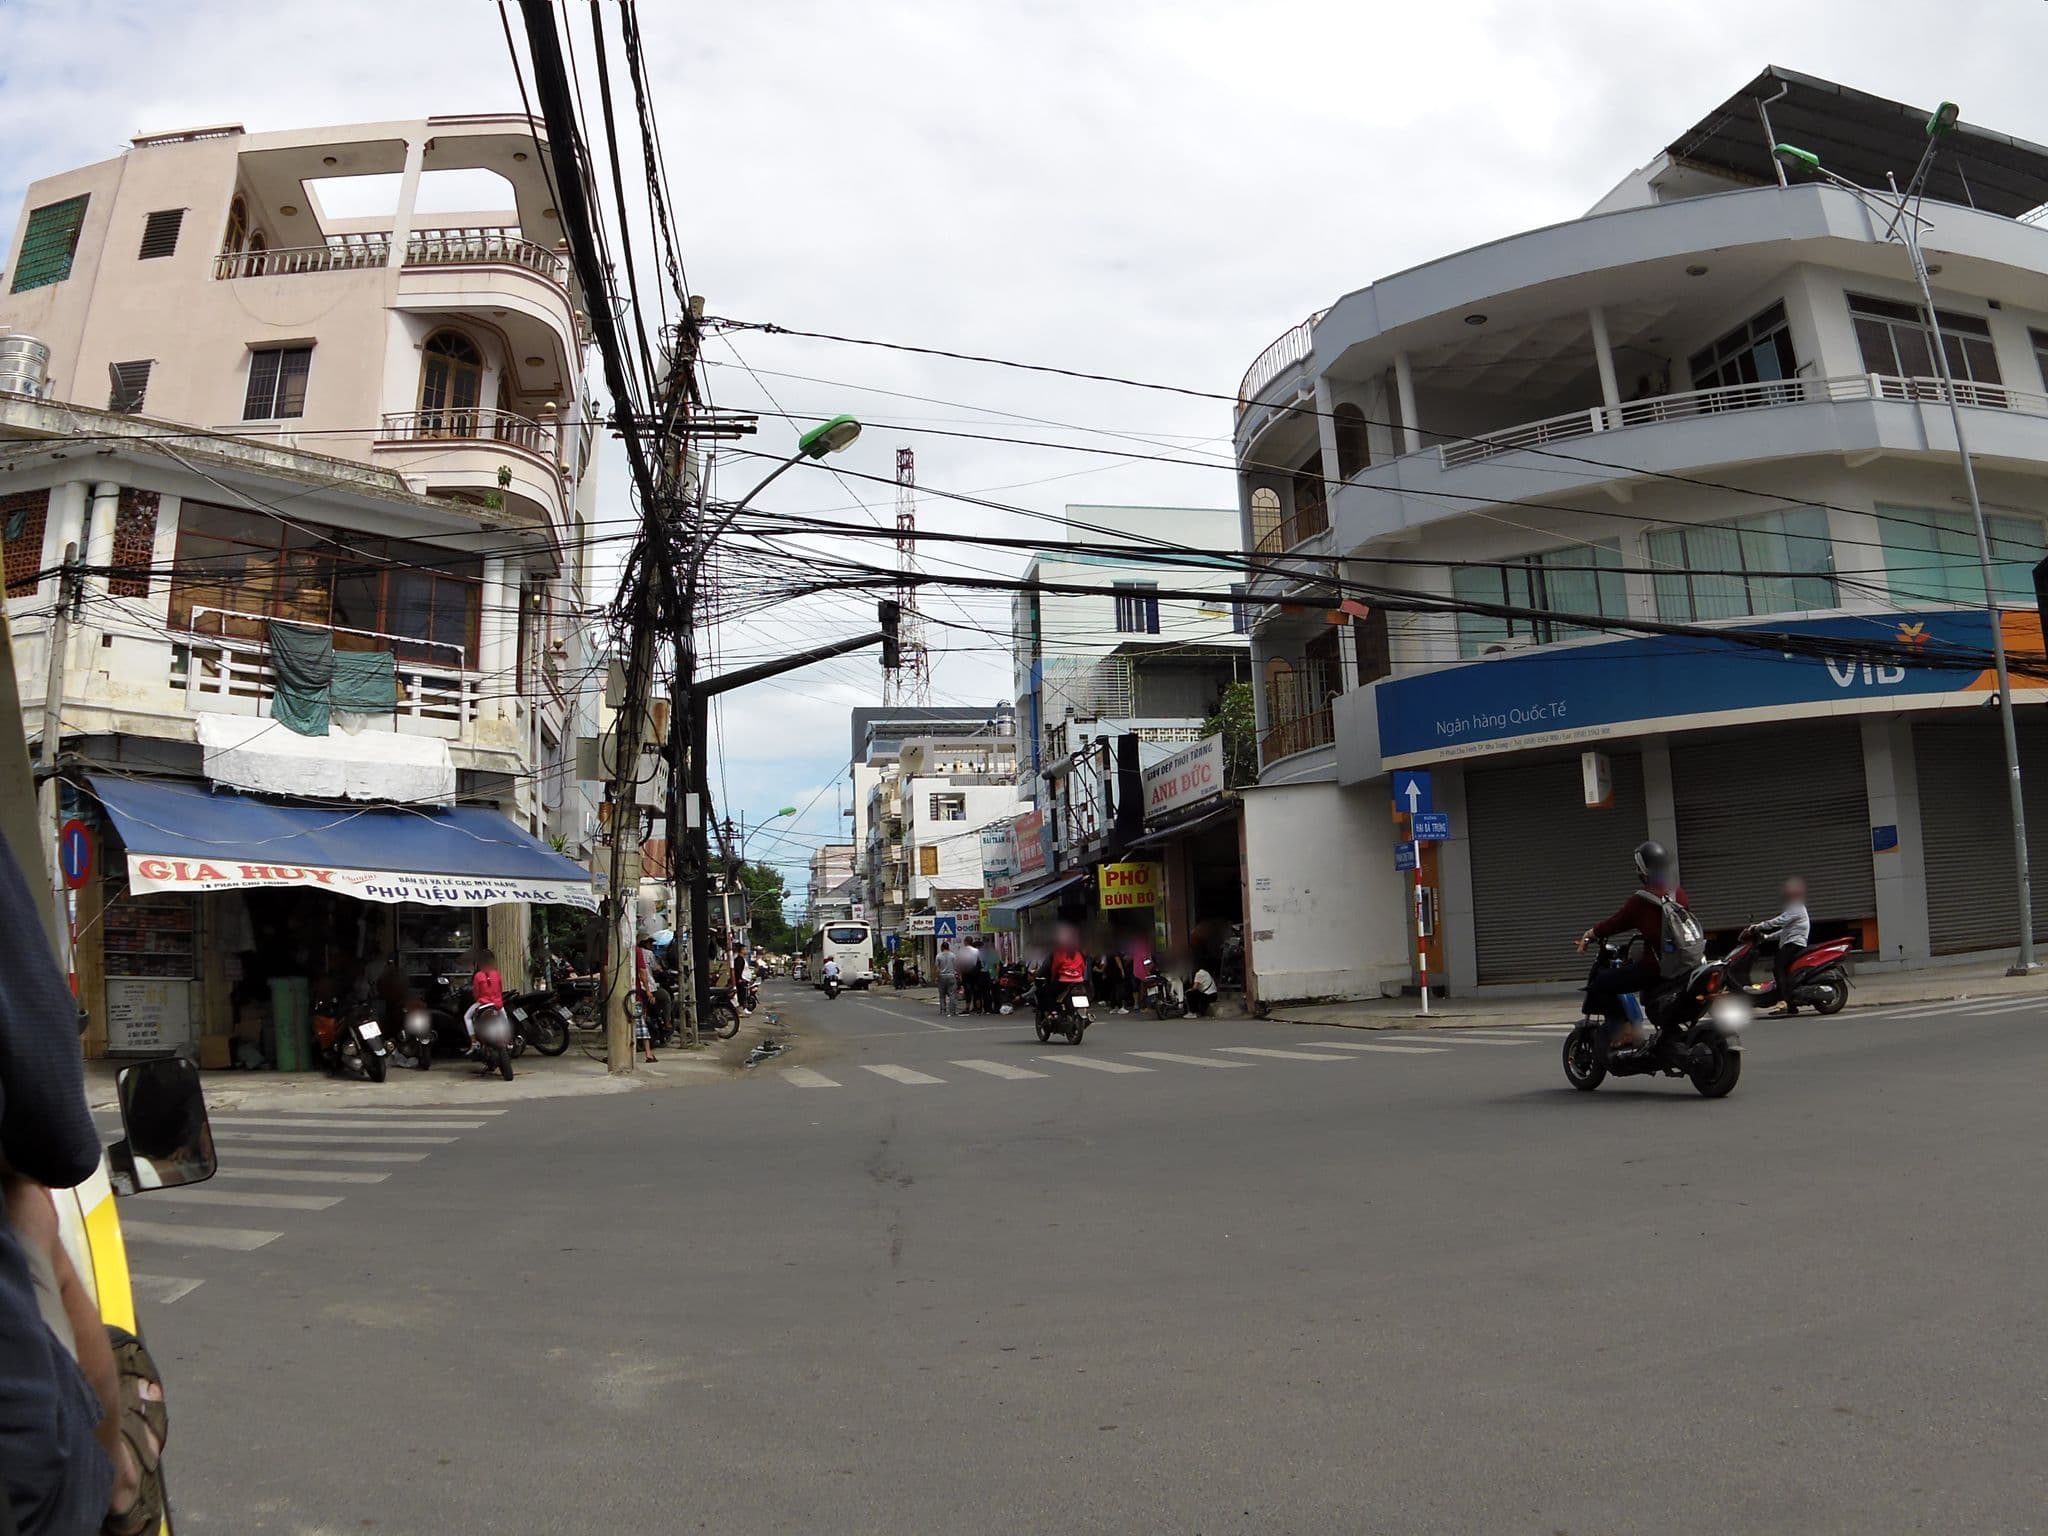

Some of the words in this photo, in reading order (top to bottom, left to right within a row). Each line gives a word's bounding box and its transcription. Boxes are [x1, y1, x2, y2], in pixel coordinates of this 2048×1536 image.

[1436, 717, 1470, 737] Ngân
[1472, 714, 1506, 729] hàng
[1509, 704, 1547, 724] Quốc
[1549, 700, 1567, 717] Tế
[1151, 777, 1178, 805] ANH
[138, 859, 228, 881] GIA
[238, 865, 338, 884] HUY
[1105, 864, 1149, 887] PHỞ
[366, 885, 409, 899] PHỤ
[415, 886, 458, 902] LIỆU
[464, 889, 506, 900] MAY
[1104, 891, 1133, 906] BÚN
